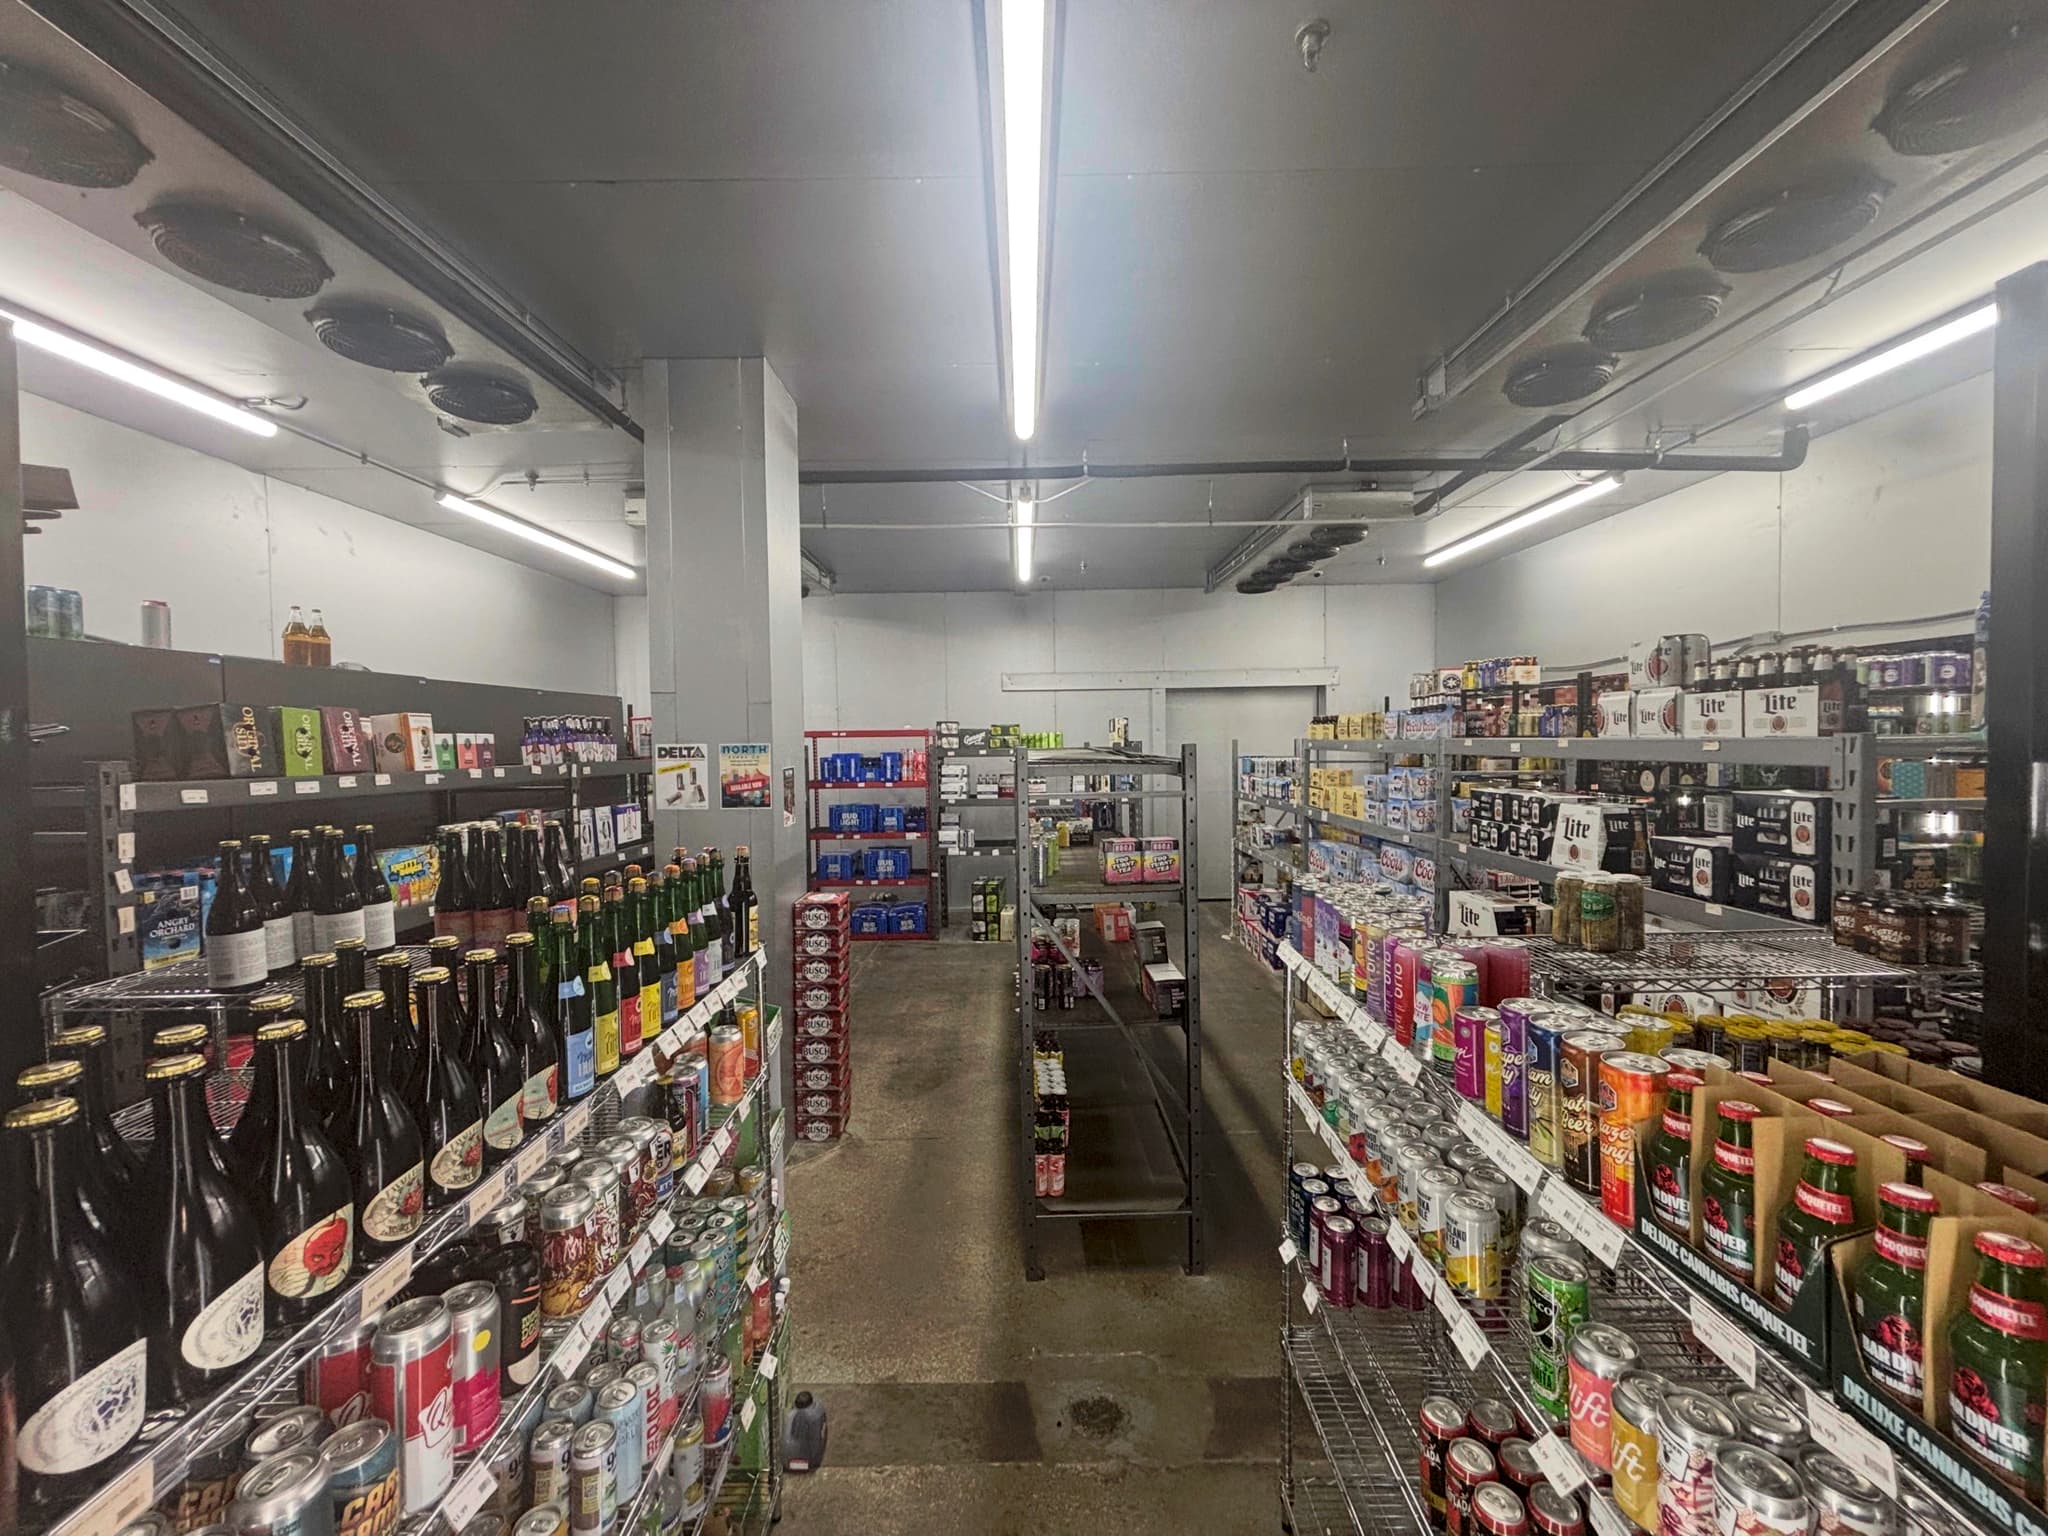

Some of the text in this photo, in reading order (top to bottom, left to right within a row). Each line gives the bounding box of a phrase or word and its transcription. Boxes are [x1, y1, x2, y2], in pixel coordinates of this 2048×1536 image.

[1699, 698, 1726, 717] Lite
[1763, 693, 1797, 714] Lite
[242, 706, 262, 772] ORIGINAL
[657, 746, 705, 759] DELTA
[1736, 814, 1755, 828] Lite
[1792, 812, 1813, 824] Lite
[1564, 817, 1591, 841] Lite
[1609, 820, 1629, 832] Lite
[1694, 858, 1711, 869] Lite
[1738, 873, 1755, 888] Lite
[1792, 875, 1813, 888] Lite
[802, 912, 830, 922] BUSCH
[1460, 904, 1480, 927] Lite
[158, 917, 188, 928] ANGRY
[149, 923, 195, 937] ORCHARD
[803, 939, 830, 949] BUSCH
[803, 966, 830, 976] BUSCH
[803, 993, 831, 1003] BUSCH
[806, 1020, 831, 1030] BUSCH
[803, 1047, 829, 1056] BUSCH
[804, 1073, 830, 1083] BUSCH
[804, 1100, 831, 1109] BUSCH
[804, 1126, 832, 1135] BUSCH
[1711, 1226, 1747, 1253] DIVER
[1882, 1239, 1926, 1259] COQUET
[1641, 1217, 1678, 1262] DELUXE
[1679, 1248, 1740, 1304] CANNABIS
[1893, 1351, 1923, 1380] DIV
[1570, 1382, 1608, 1429] lift
[1966, 1405, 2030, 1454] DIVER
[1843, 1375, 2013, 1527] DELUXE CANNABIS
